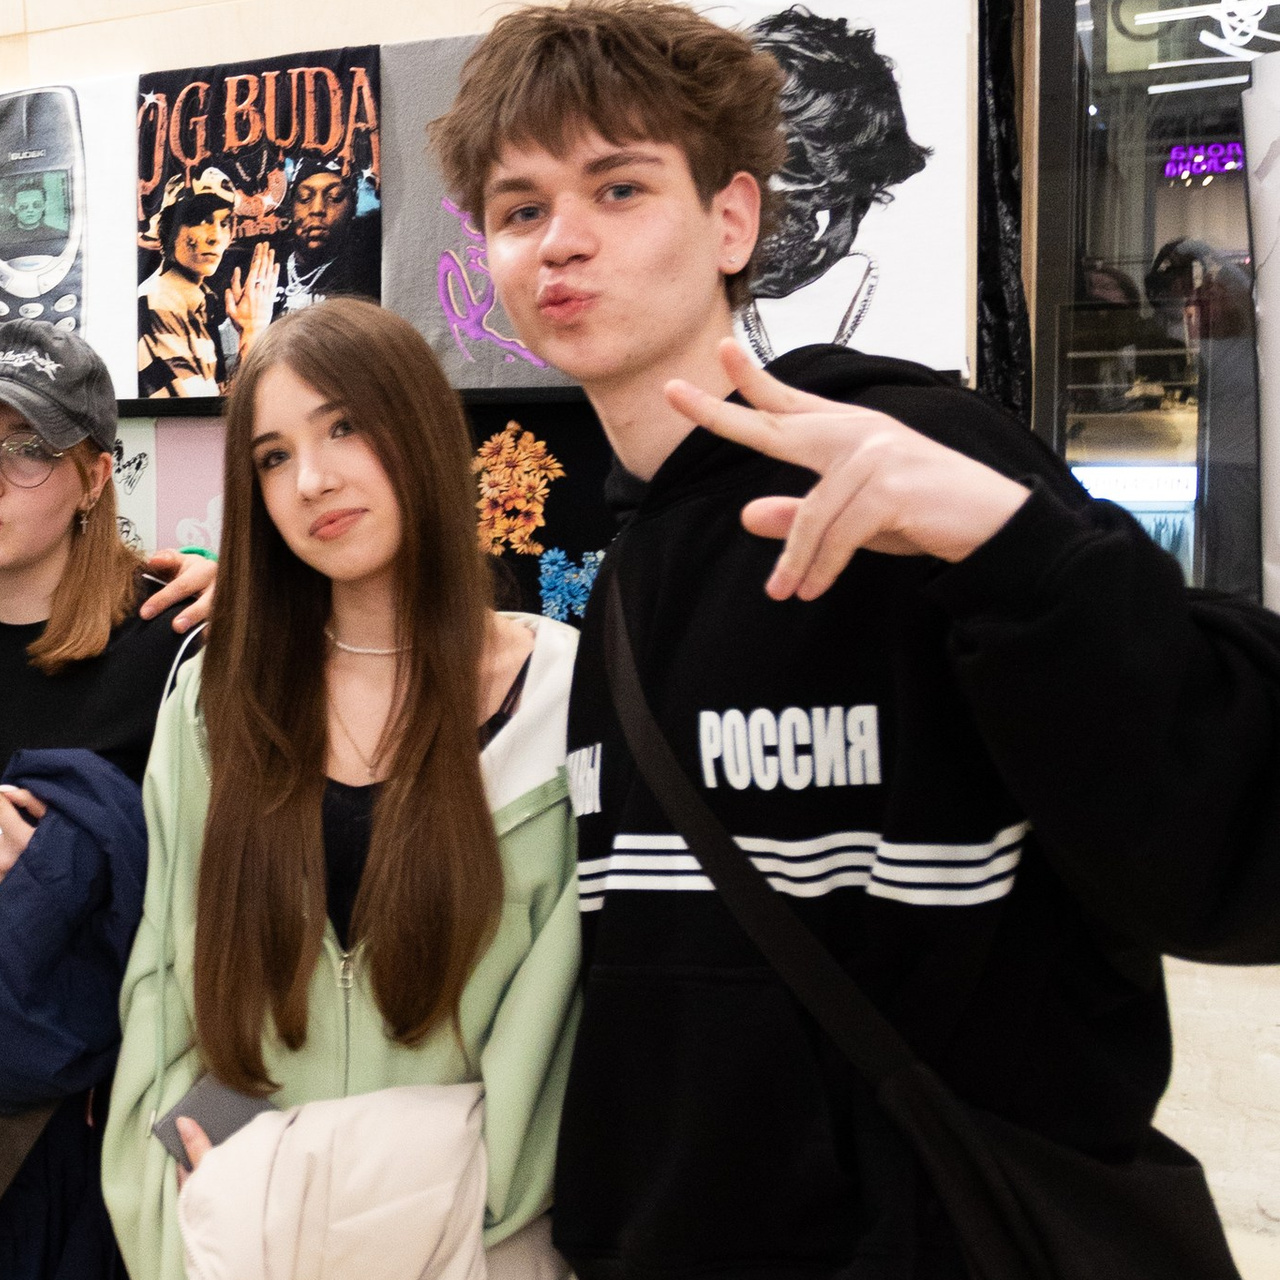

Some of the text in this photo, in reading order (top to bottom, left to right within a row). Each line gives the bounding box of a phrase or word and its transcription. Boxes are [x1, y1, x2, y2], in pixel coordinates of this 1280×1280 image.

[138, 66, 381, 197] OG BUDA
[698, 704, 882, 791] РОССИЯ
